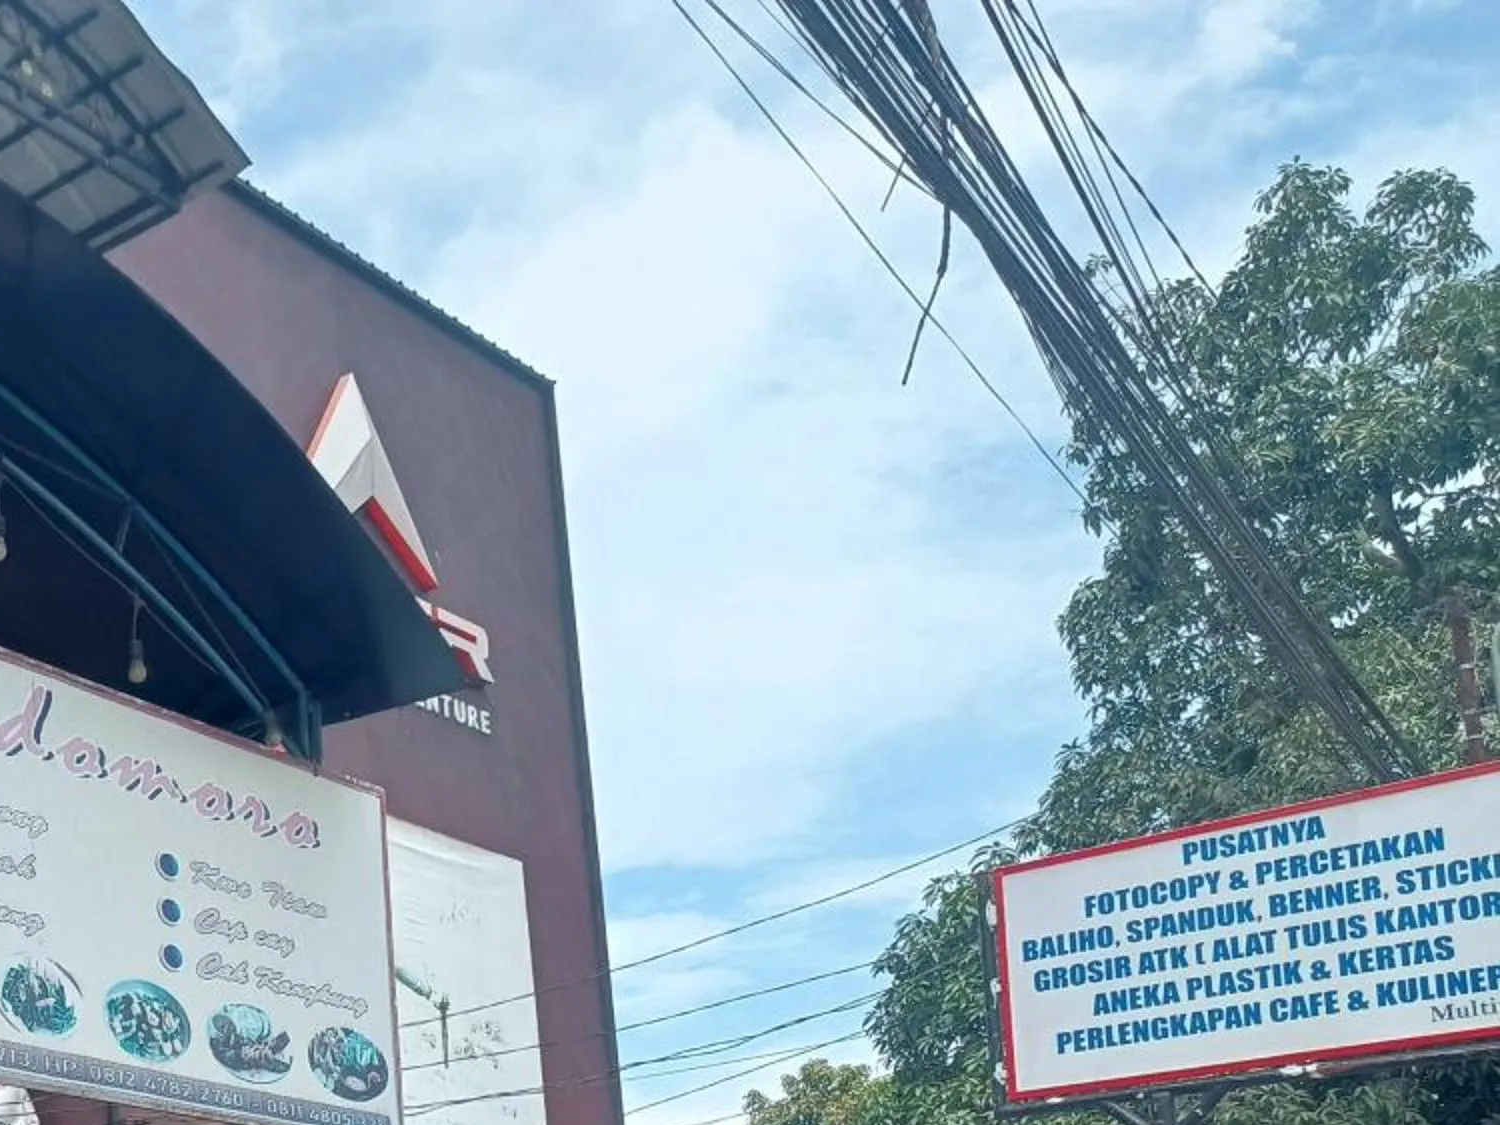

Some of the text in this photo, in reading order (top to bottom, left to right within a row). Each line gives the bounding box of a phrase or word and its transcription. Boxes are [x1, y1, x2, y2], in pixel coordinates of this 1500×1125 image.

[415, 696, 492, 735] NTURE
[1084, 827, 1446, 918] FOTOCOPY & PERCETAKAN
[1182, 815, 1326, 866] PUSATNYA
[1022, 924, 1121, 963] BALIHO,
[1127, 897, 1263, 944] SPANDUK,
[1269, 878, 1389, 918] BENNER,
[1033, 956, 1133, 994] GROSIR
[1138, 945, 1189, 976] ATK
[1212, 928, 1276, 963] ALAT
[1284, 913, 1367, 949] TULIS
[1374, 890, 1500, 934] KANTOR
[1093, 935, 1456, 1017] ANEKA PLASTIK & KERTAS
[1056, 1002, 1263, 1055] PERLENGKAPAN
[1270, 989, 1341, 1025] CAFE
[1347, 989, 1369, 1011] &
